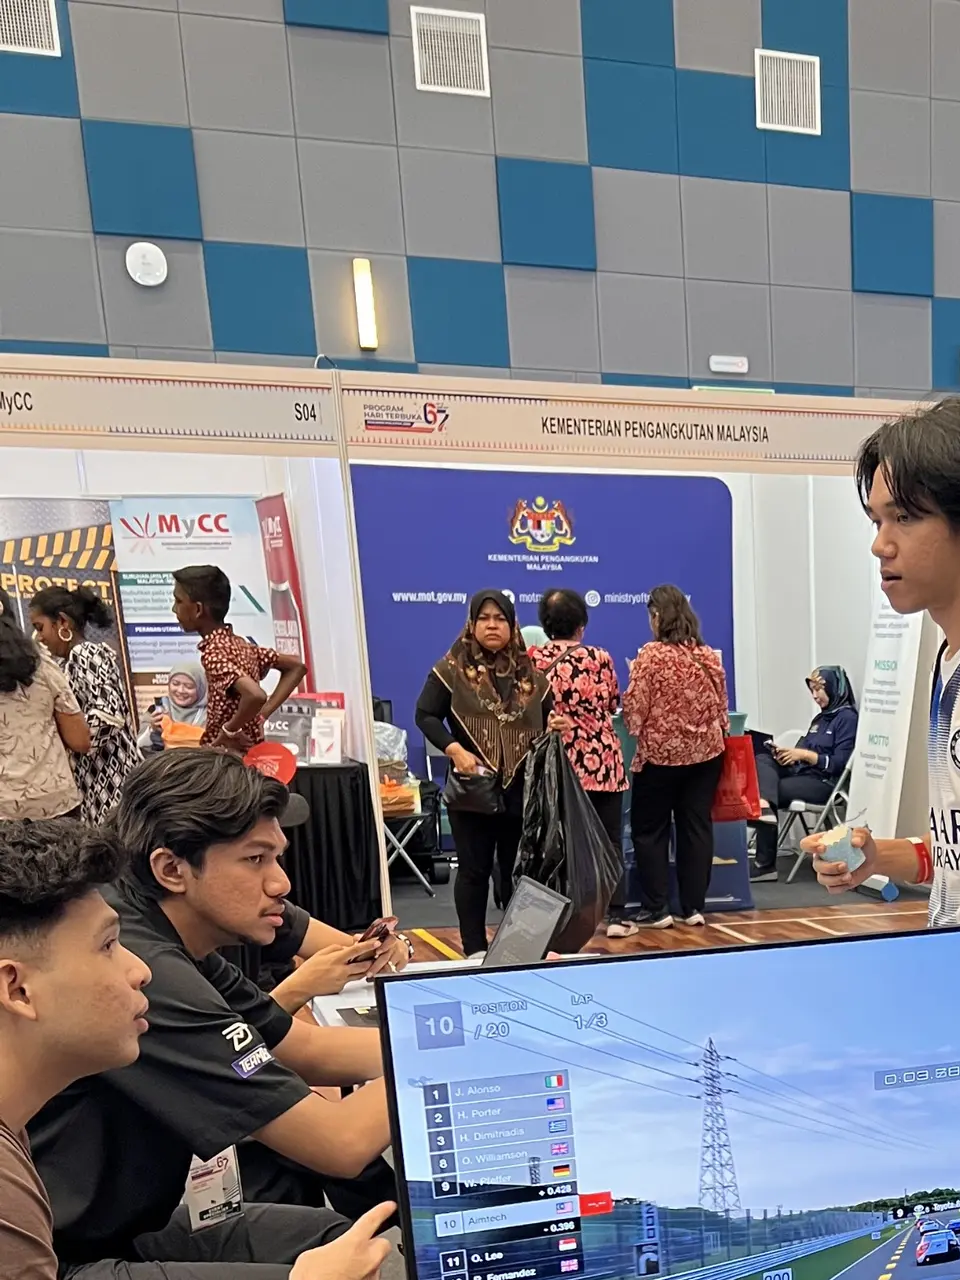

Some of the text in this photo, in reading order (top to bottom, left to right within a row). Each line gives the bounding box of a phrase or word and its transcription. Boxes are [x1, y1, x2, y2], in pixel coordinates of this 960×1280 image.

[294, 402, 317, 422] S04
[363, 404, 404, 413] PROGRAM
[386, 412, 422, 421] TERBUKA
[541, 416, 769, 443] KEMENTERIAN PENGANGKUTAN MALAYSIA
[158, 513, 230, 538] MyCC
[487, 554, 599, 563] KEMENTERIAN PENGANGKUTAN
[526, 563, 563, 571] MALAYSIA
[392, 591, 467, 604] www.mot.gov.my
[571, 994, 593, 1006] LAP
[471, 1000, 528, 1015] POSITION
[425, 1016, 454, 1036] 10
[574, 1013, 608, 1030] 1/3
[486, 1022, 510, 1039] 20
[432, 1089, 440, 1100] 1
[455, 1084, 501, 1097] J. Alonso
[434, 1112, 443, 1124] 2
[457, 1107, 501, 1120] H. Porter
[436, 1136, 446, 1147] 3
[459, 1132, 470, 1143] H.
[475, 1150, 528, 1164] Williamson
[439, 1158, 448, 1169] 8
[441, 1181, 450, 1192] 9
[444, 1219, 457, 1229] 10
[468, 1212, 507, 1226] Aimtech
[446, 1255, 460, 1267] 11
[485, 1251, 504, 1262] Lee
